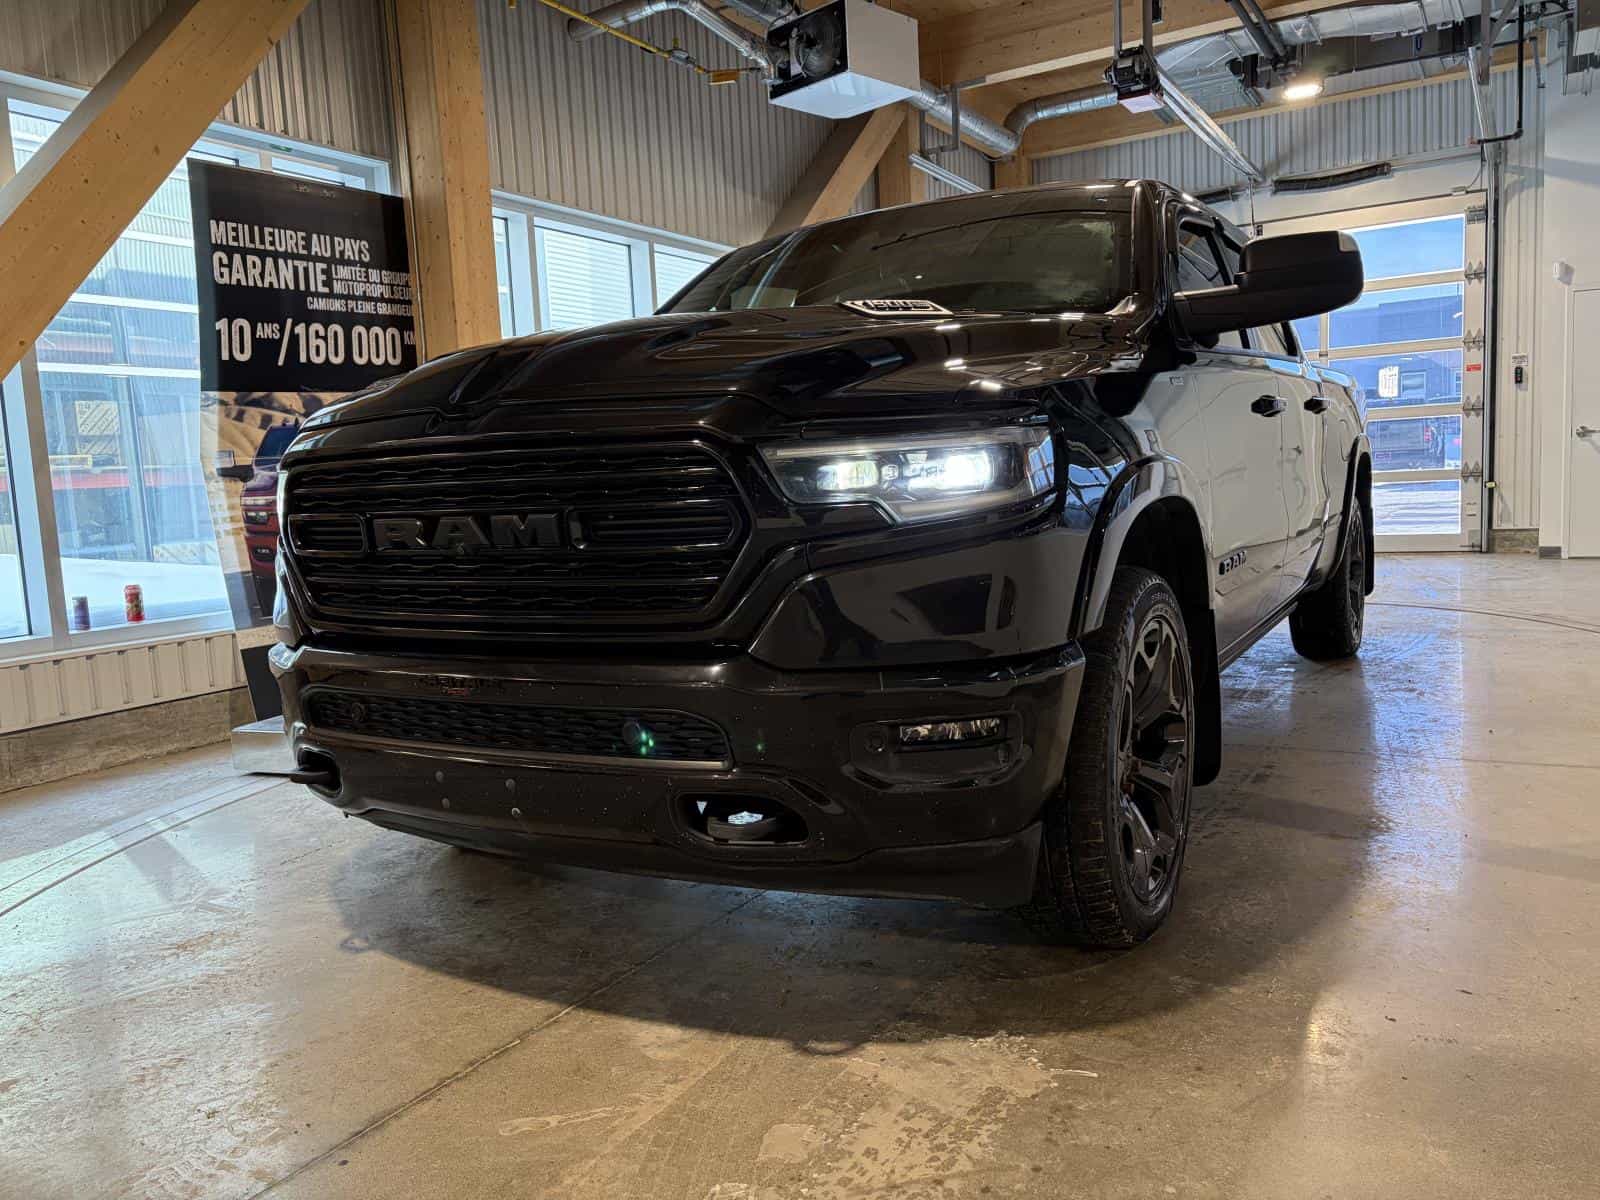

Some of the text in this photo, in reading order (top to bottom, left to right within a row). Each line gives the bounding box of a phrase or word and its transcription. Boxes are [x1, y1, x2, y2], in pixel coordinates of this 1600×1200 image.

[210, 219, 370, 263] MEILLEURE AU PAYS
[212, 251, 330, 293] GARANTIE
[331, 263, 367, 282] LIMITÉE
[368, 268, 381, 283] DU
[307, 297, 412, 317] CAMIONS PLEINE GRANDEU
[215, 318, 252, 362] 10
[256, 322, 280, 340] ANS
[352, 325, 402, 366] 000
[372, 513, 561, 548] RAM
[1218, 550, 1247, 576] RAM
